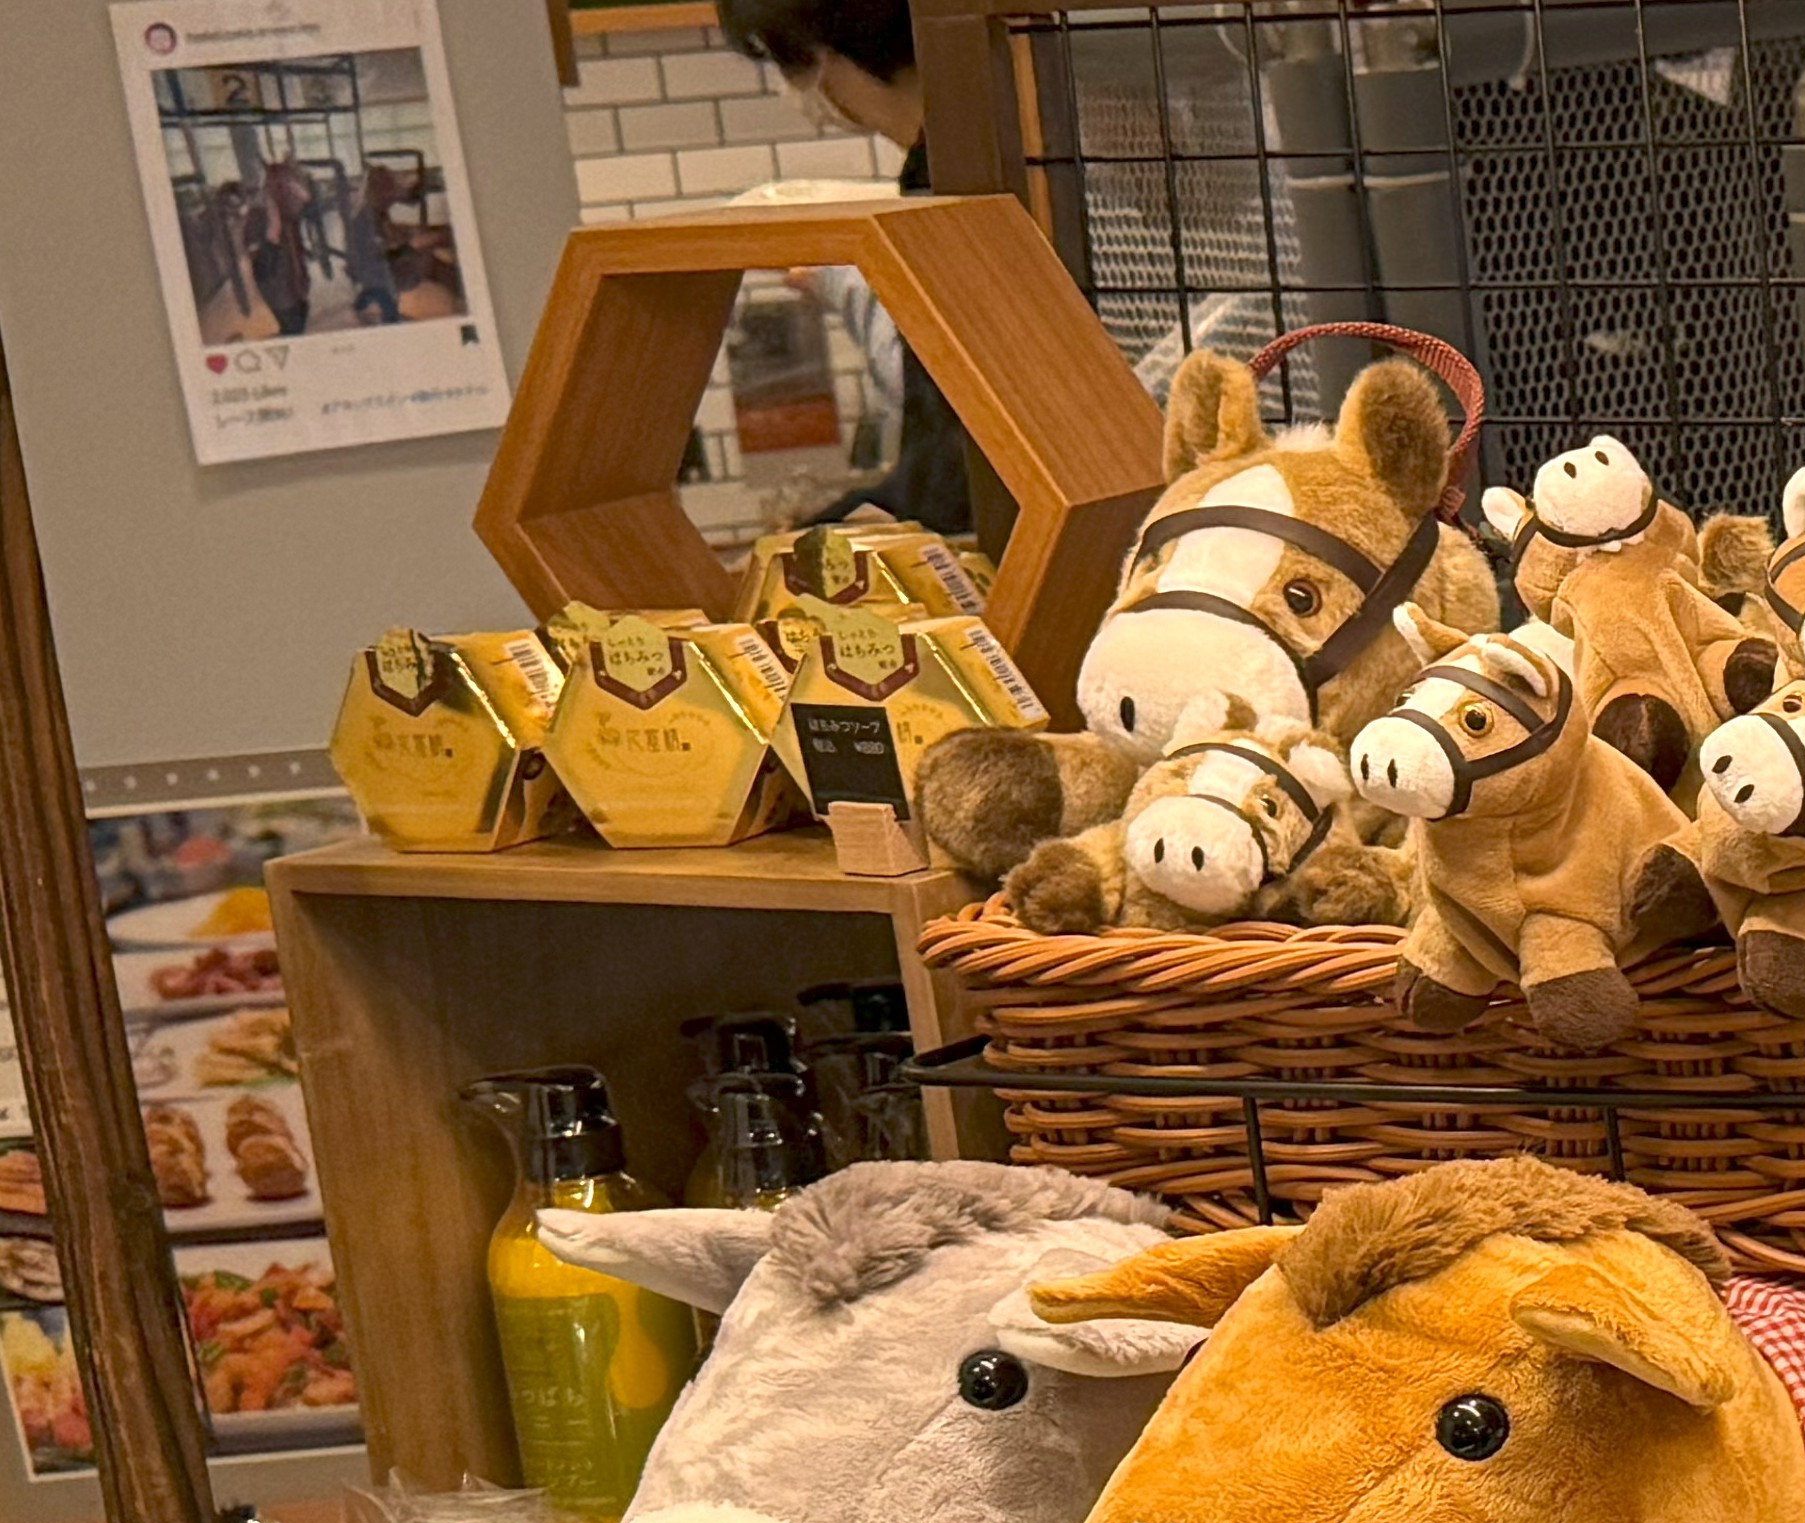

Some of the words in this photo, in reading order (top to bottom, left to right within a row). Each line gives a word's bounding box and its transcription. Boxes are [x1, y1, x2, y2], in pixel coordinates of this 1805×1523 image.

[608, 651, 664, 667] はちみつ
[839, 643, 896, 659] はちみつ
